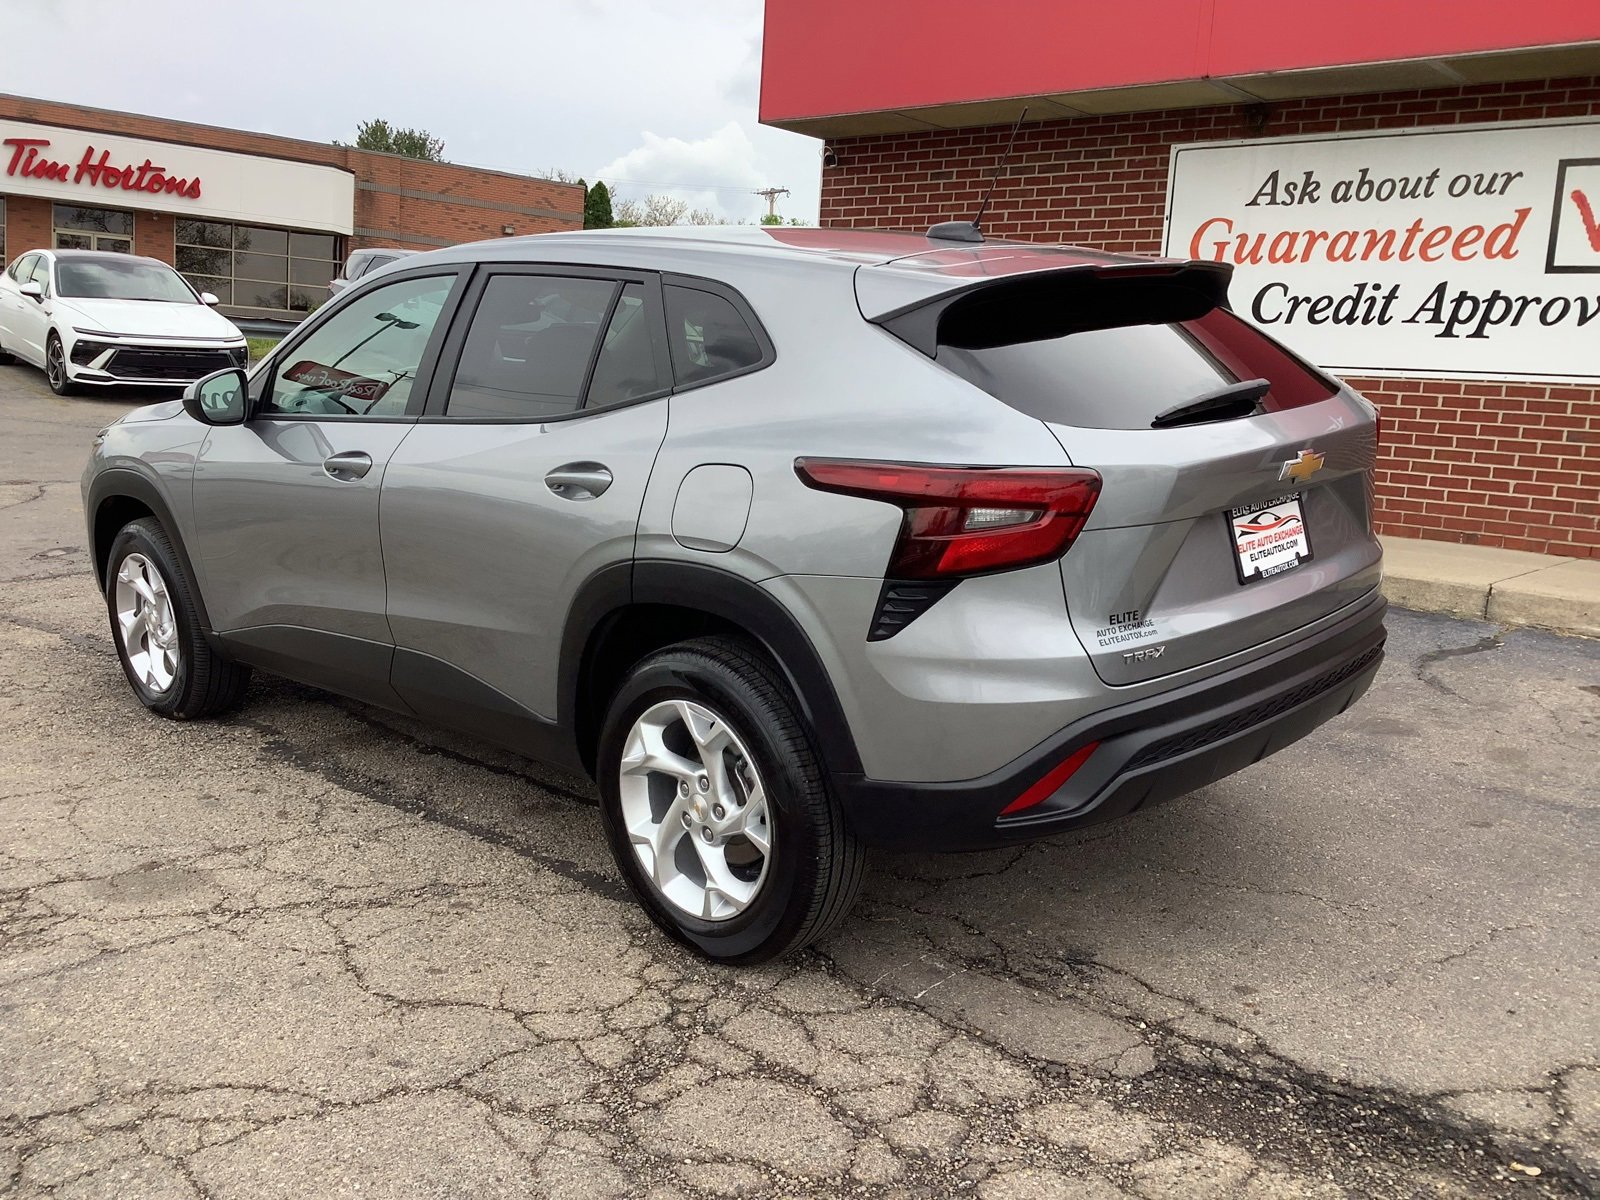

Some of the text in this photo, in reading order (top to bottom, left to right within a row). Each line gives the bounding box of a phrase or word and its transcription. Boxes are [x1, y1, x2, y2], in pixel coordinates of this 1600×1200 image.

[3, 138, 201, 199] Tim Hortons
[1245, 168, 1523, 207] Ask about our
[1189, 207, 1532, 266] Guaranteed
[1251, 282, 1401, 326] Credit
[1237, 525, 1304, 554] ELITE AUTO EXCHANGE
[1249, 538, 1298, 562] ELITEAUTOX.COM
[1096, 619, 1154, 638] AUTO EXCHANGE
[1109, 610, 1139, 625] ELITE
[1098, 629, 1159, 647] ELITEAUTOX.com
[1122, 646, 1166, 664] TRAX
